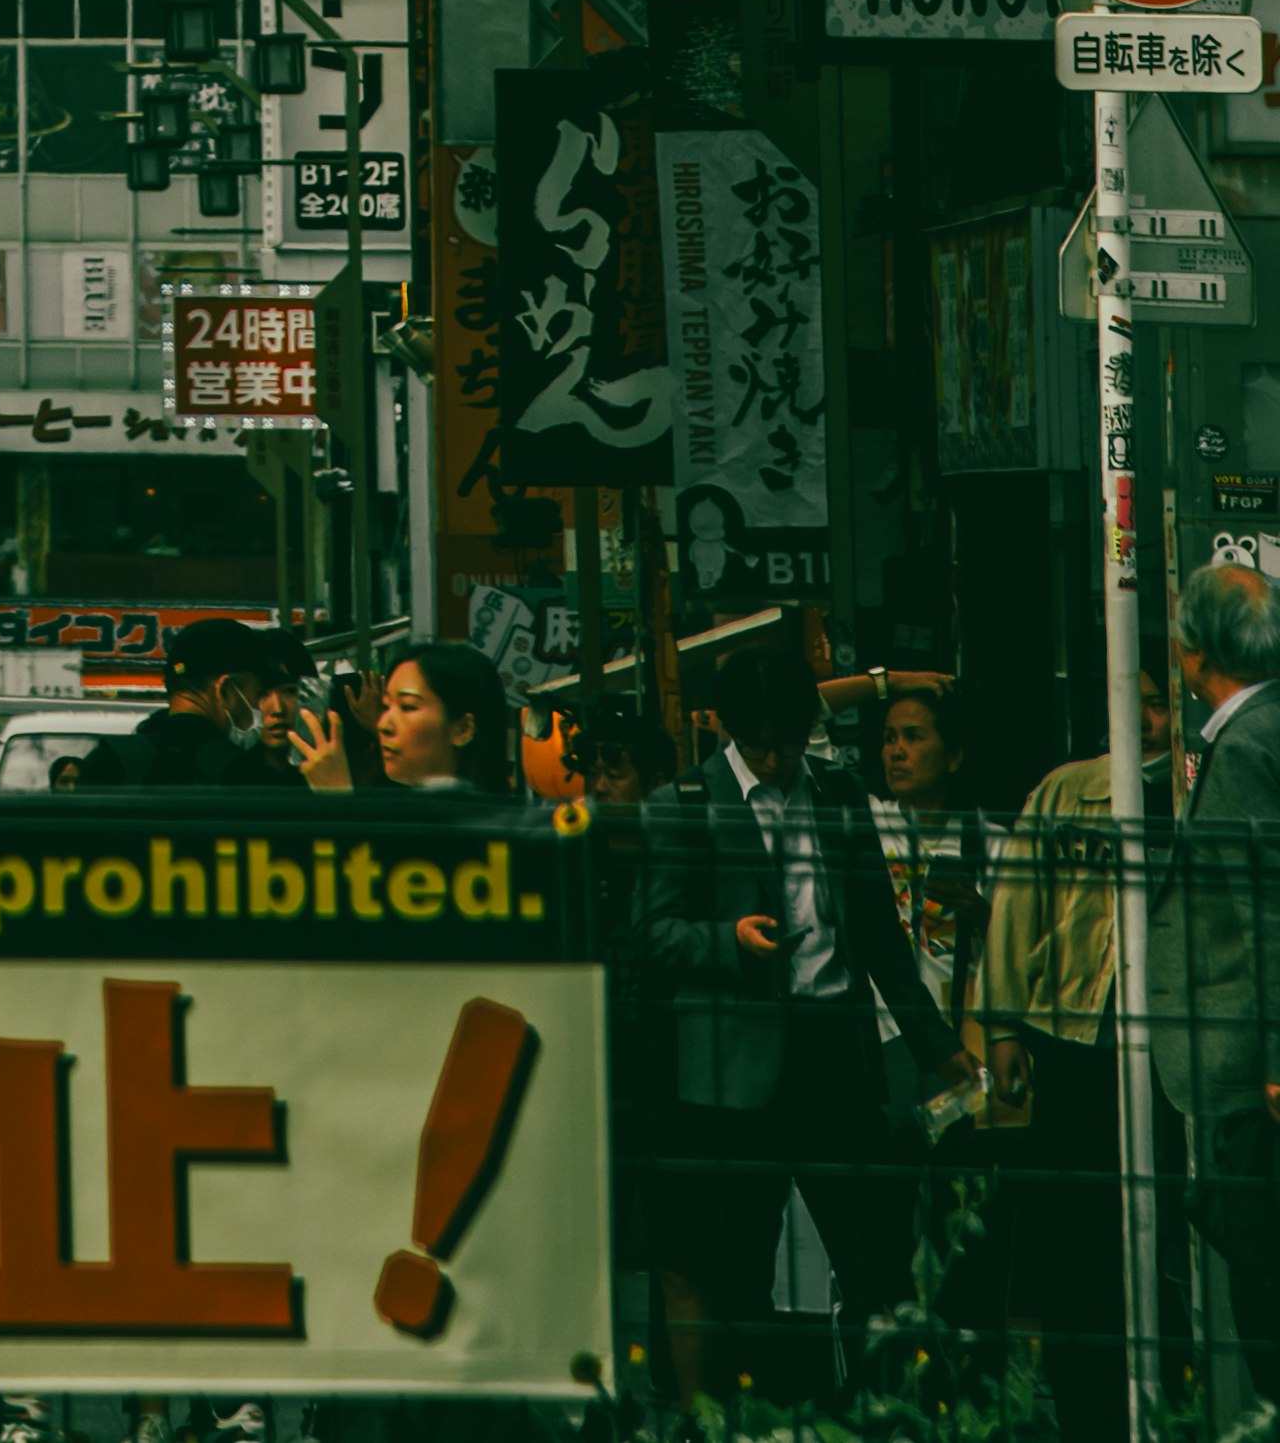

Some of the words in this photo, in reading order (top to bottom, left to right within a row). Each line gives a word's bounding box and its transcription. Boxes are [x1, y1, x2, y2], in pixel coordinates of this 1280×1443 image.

[1071, 32, 1247, 77] 自転車を除く
[673, 162, 704, 294] HIROSHIMA
[82, 256, 106, 332] BLUE
[185, 307, 317, 353] 24時間
[185, 361, 318, 408] 営業中
[1229, 494, 1263, 510] FGP
